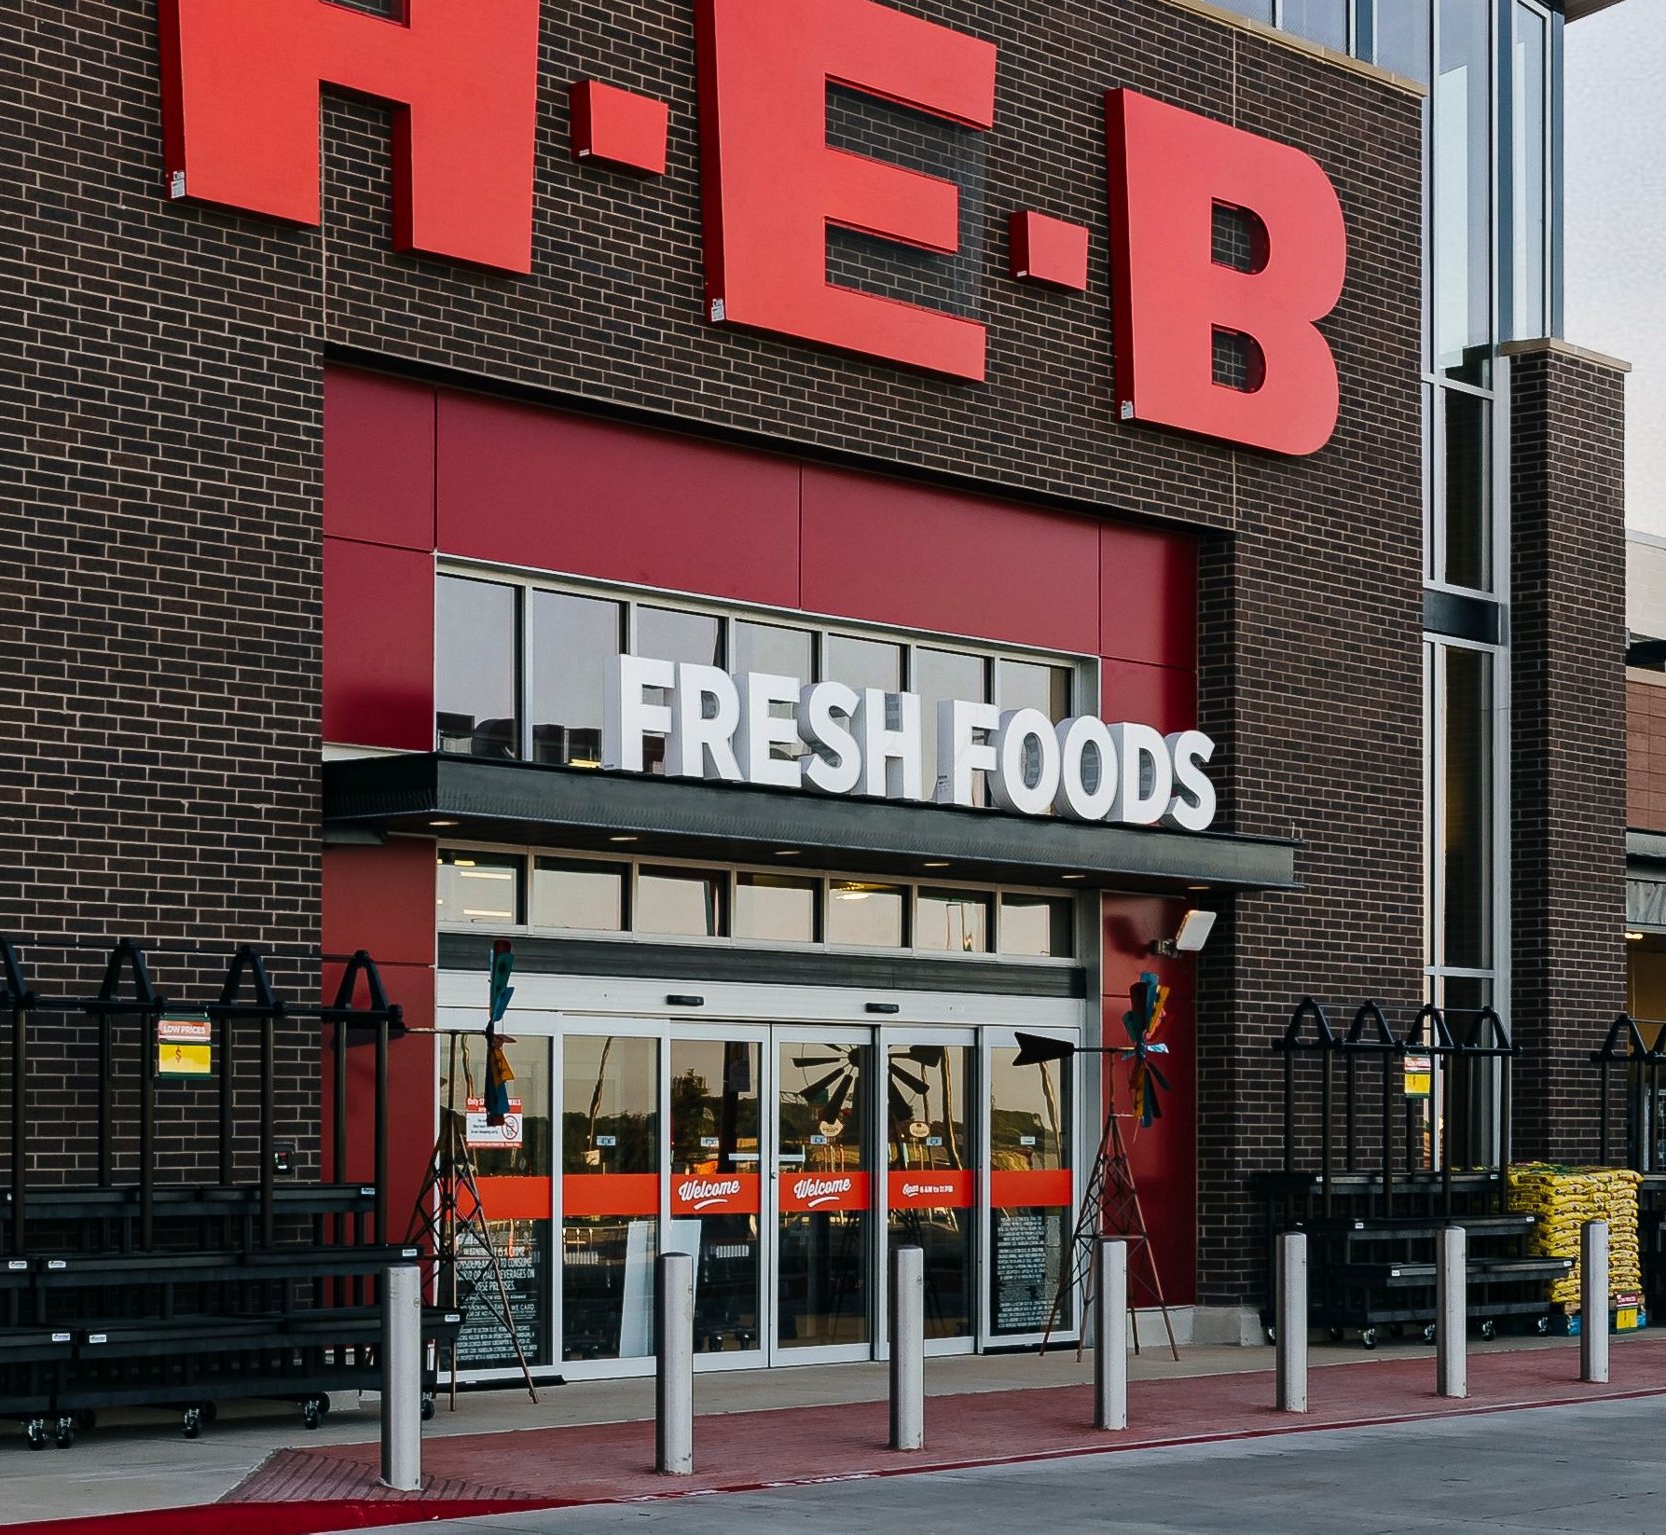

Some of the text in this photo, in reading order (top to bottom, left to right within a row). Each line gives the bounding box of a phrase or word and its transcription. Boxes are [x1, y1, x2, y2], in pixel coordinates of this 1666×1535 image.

[604, 654, 1217, 832] FRESH FOODS
[163, 1025, 206, 1034] LOW PRICES
[678, 1179, 741, 1201] Welcome
[793, 1178, 852, 1199] Welcome
